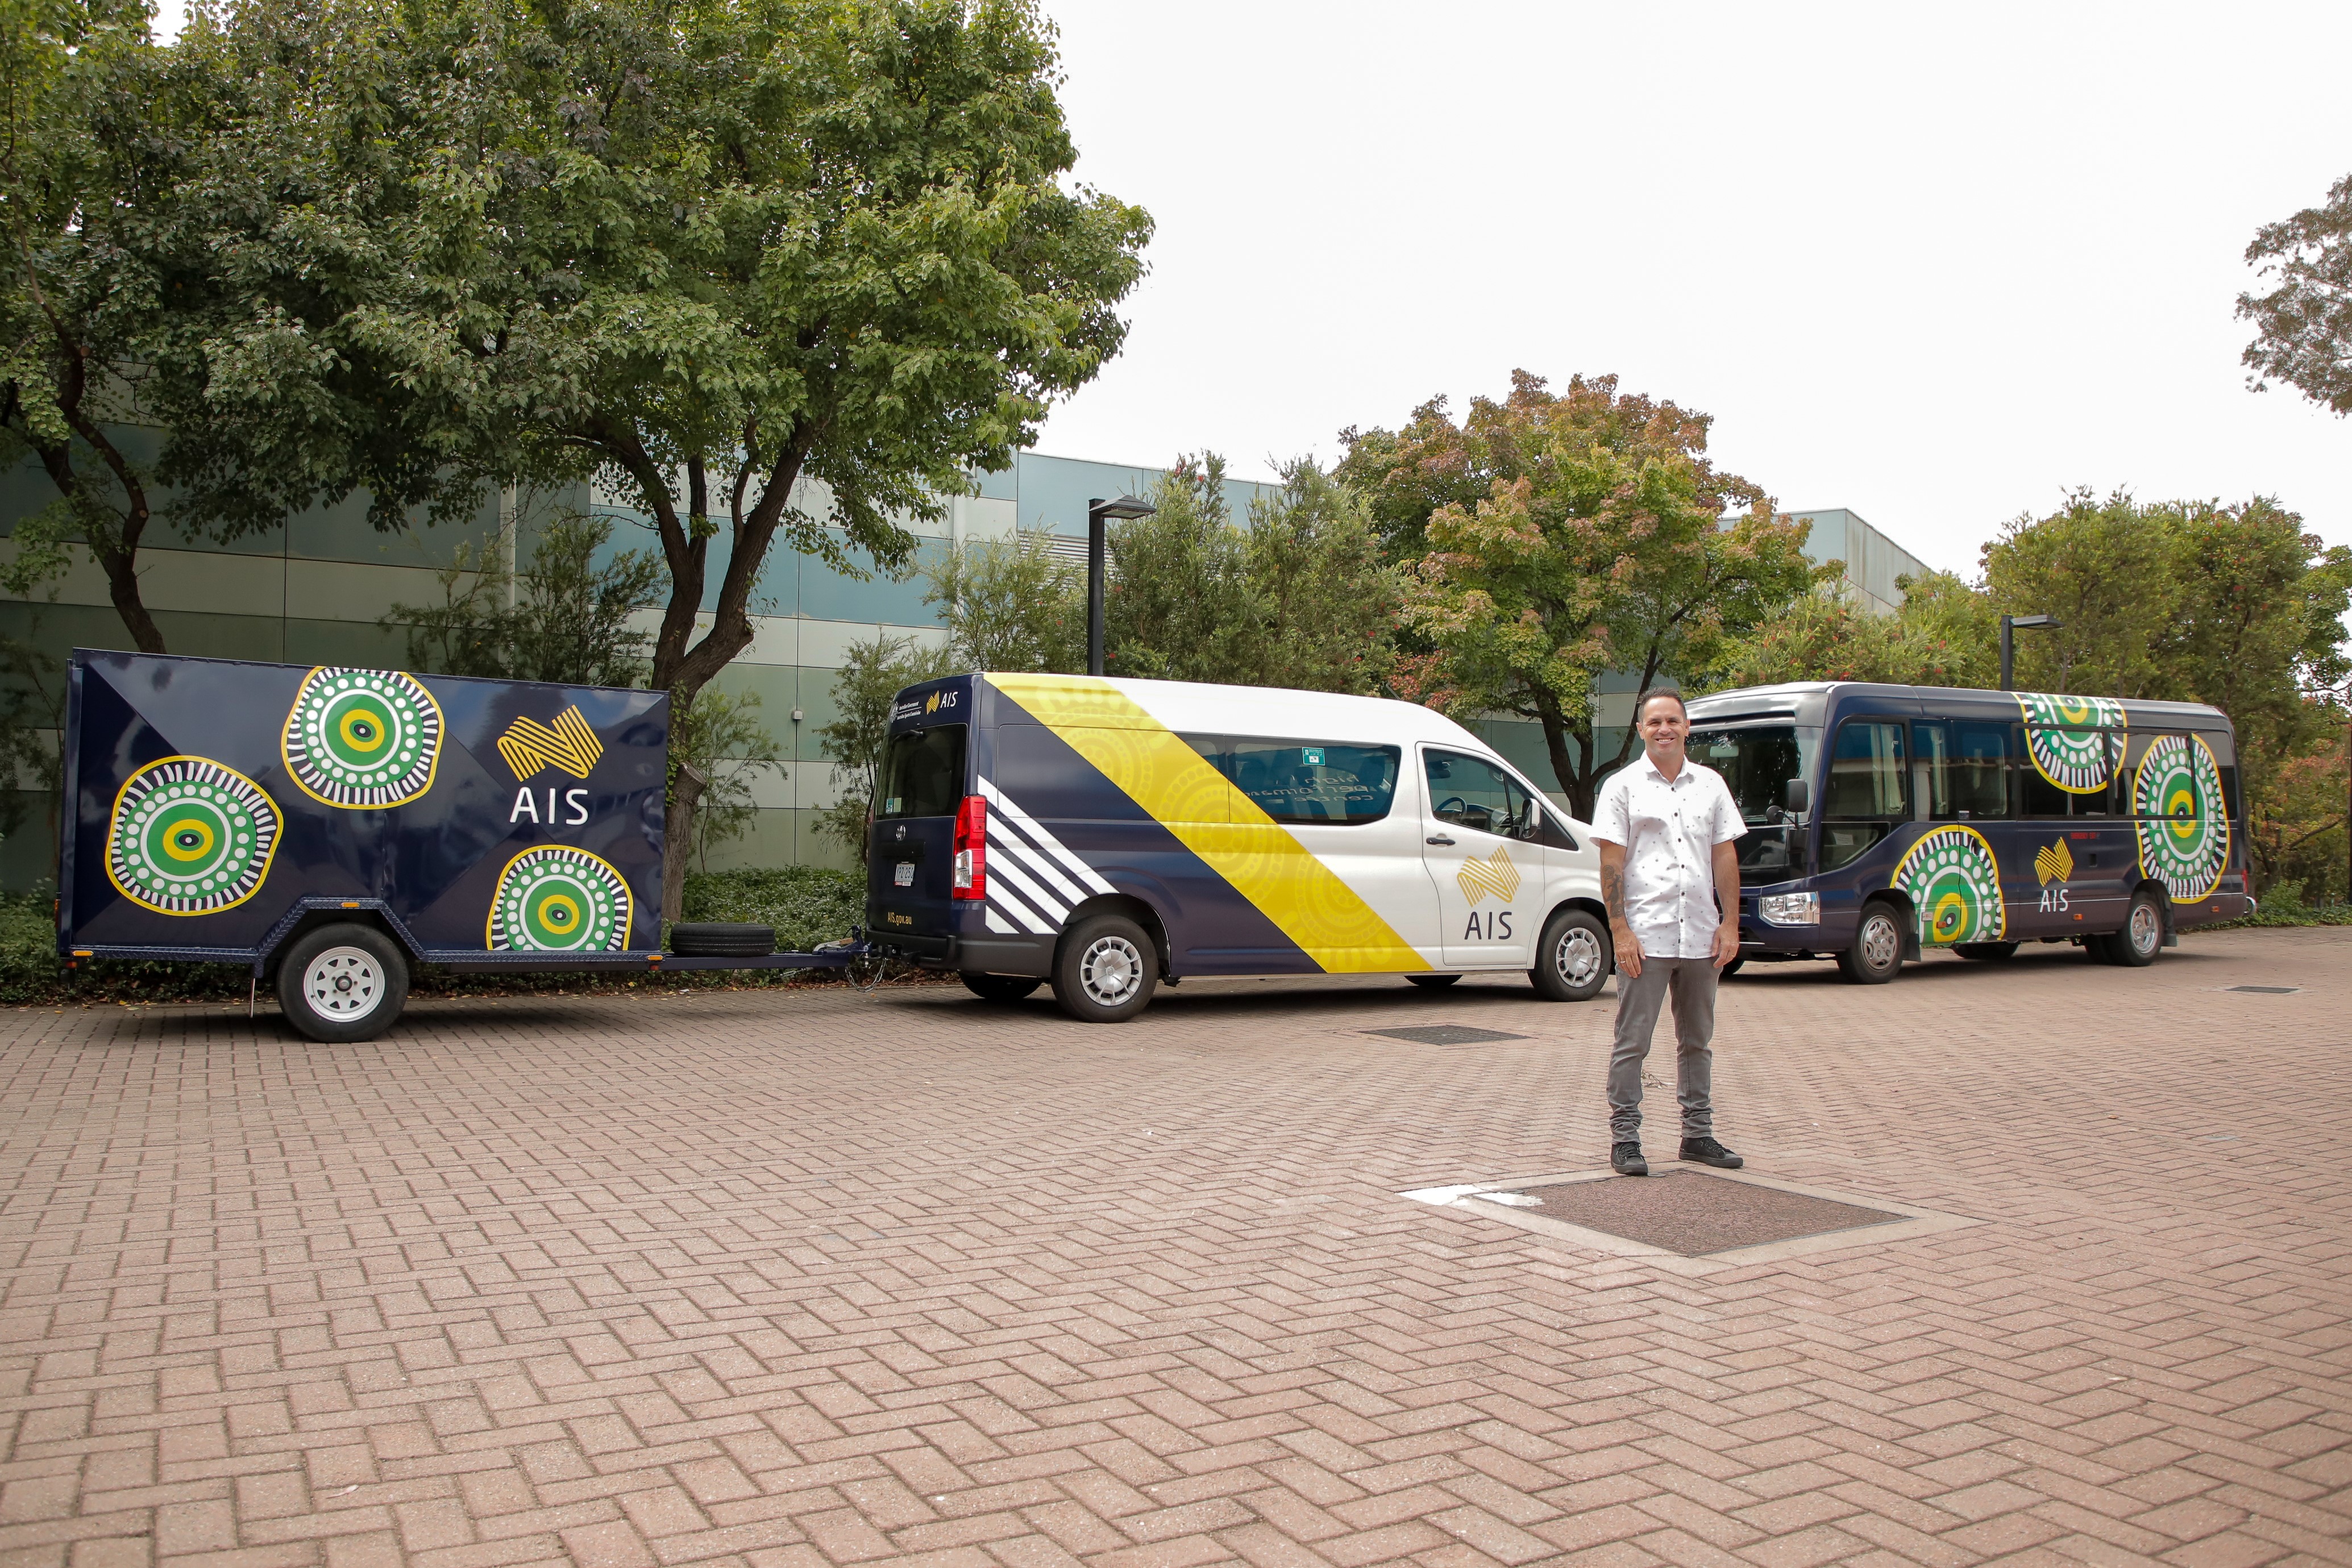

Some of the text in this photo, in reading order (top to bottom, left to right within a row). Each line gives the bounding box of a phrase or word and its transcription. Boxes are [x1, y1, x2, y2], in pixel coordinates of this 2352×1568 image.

[940, 691, 958, 708] AIS
[509, 787, 588, 825] AIS
[2039, 889, 2068, 913] AIS
[888, 912, 912, 926] AIS.gov.au
[1464, 912, 1512, 939] AIS
